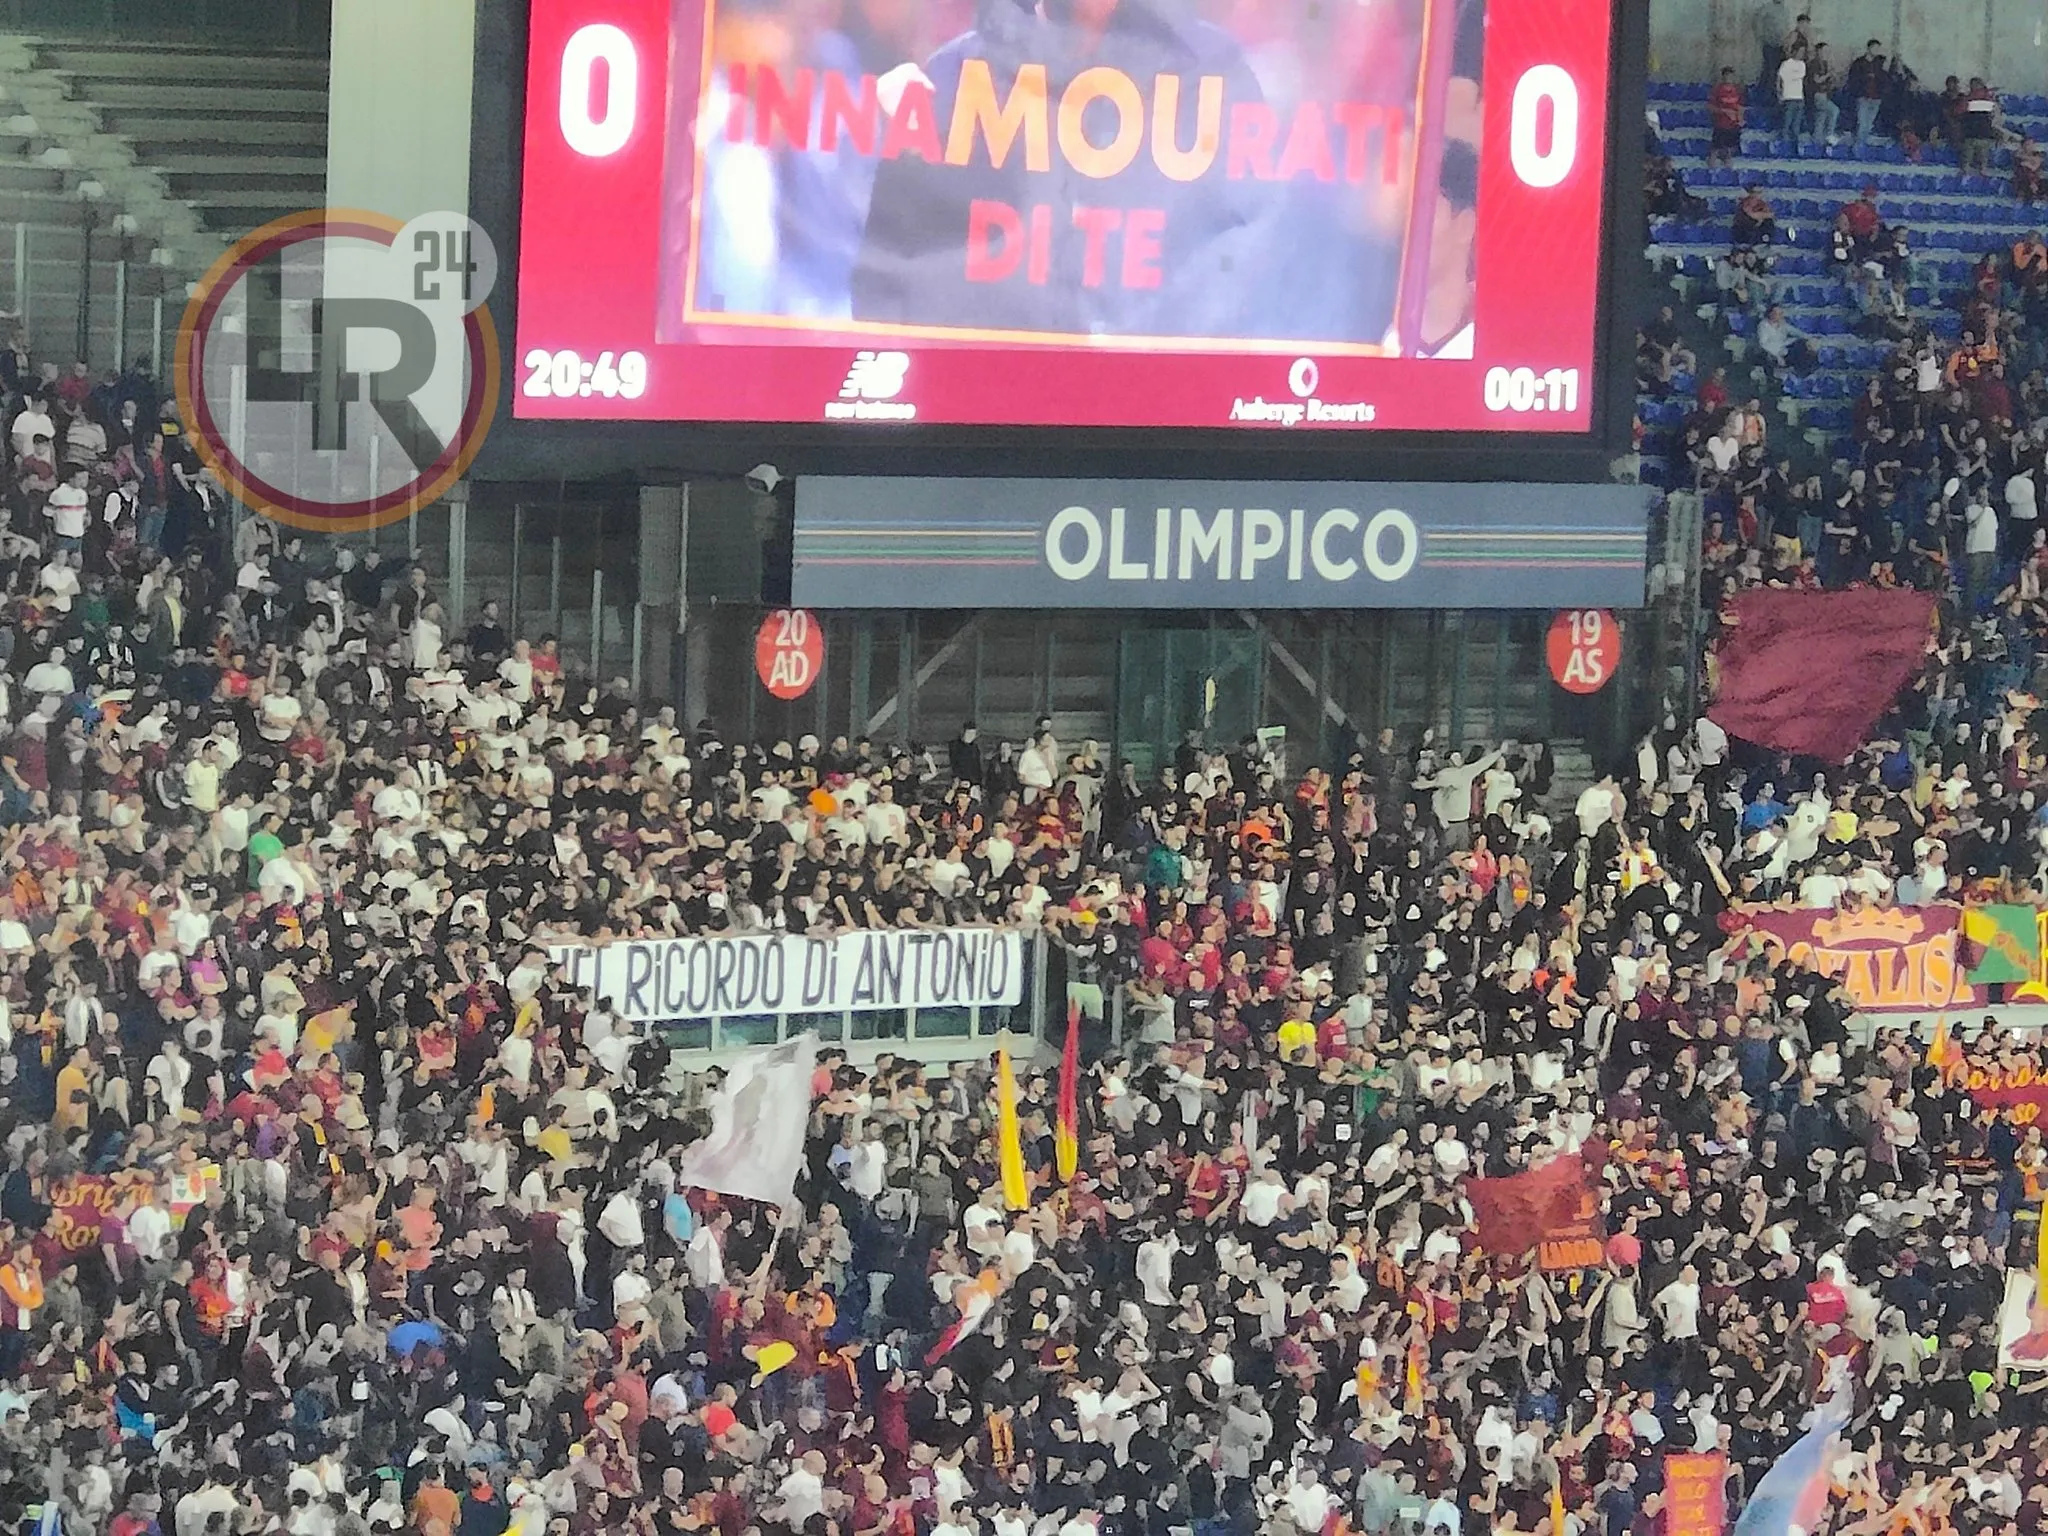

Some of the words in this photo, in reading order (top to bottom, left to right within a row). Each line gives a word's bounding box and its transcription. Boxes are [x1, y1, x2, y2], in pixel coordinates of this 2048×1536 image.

[558, 23, 638, 157] 0
[1509, 63, 1579, 188] 0
[964, 197, 1052, 287] DI
[1072, 207, 1166, 291] TE
[522, 349, 647, 400] 20:49
[1483, 367, 1578, 414] 00:11
[1045, 506, 1419, 582] OLIMPICO
[775, 609, 807, 646] 20
[1568, 610, 1602, 646] 19
[767, 650, 809, 688] AD
[1562, 648, 1603, 684] AS
